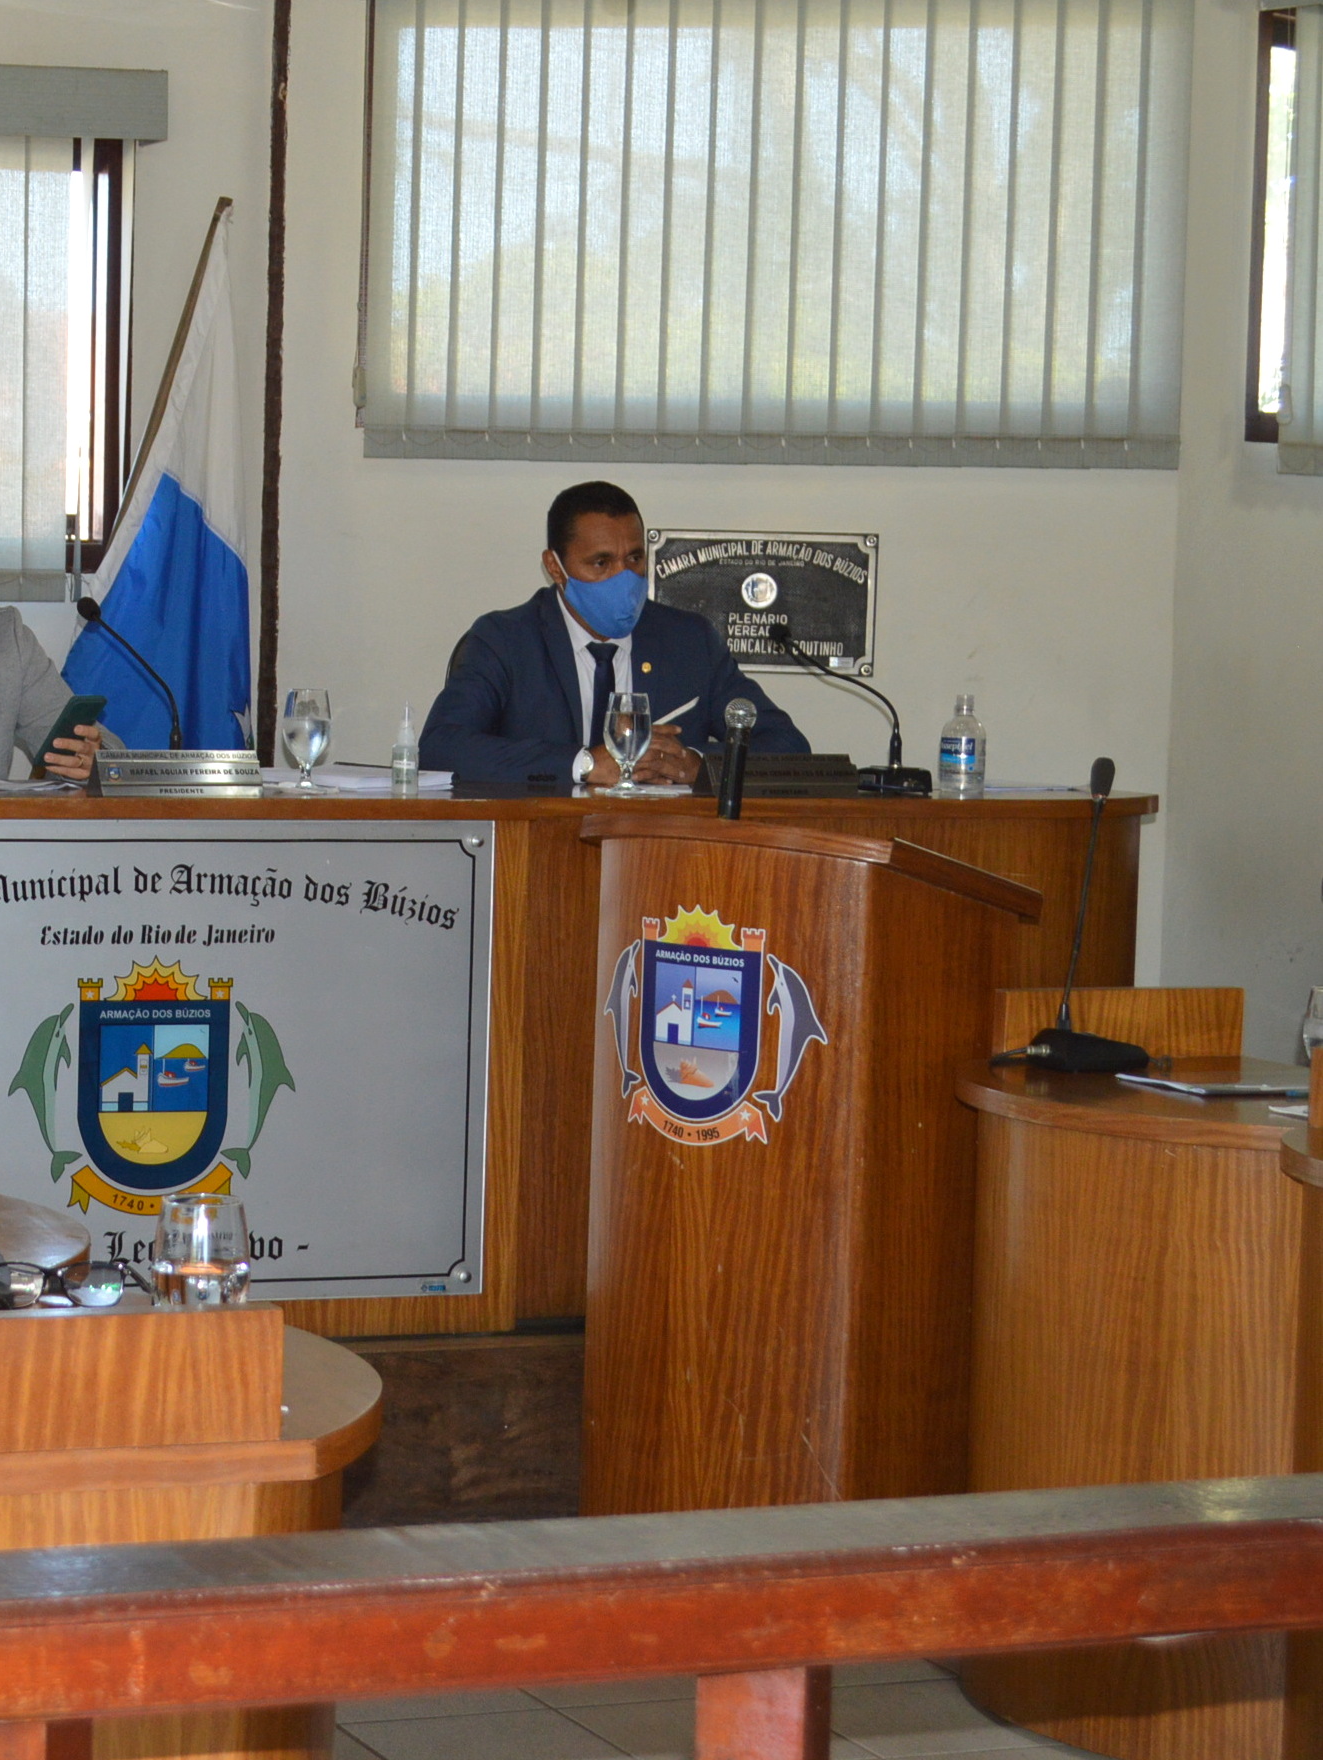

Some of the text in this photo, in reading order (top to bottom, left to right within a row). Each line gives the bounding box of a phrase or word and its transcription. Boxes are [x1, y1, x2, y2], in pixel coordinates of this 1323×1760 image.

[656, 541, 868, 584] CÂMARA MUNICIPAL DE ARMAÇÃO DOS BÚZIOS
[728, 611, 788, 626] PLENÁRIO
[792, 640, 844, 657] COUTINHO
[130, 768, 260, 776] RAFAEL AGUIAR PEREIRA DE SOUZA
[132, 866, 163, 895] de
[169, 863, 293, 907] Armação
[303, 874, 353, 907] dos
[360, 879, 460, 931] Búzios
[40, 923, 276, 947] Estado do Rio de Janeiro
[655, 949, 745, 968] ARMAÇÃO DOS BÚZIOS
[99, 1007, 211, 1020] ARMAÇÃO DOS BÚZIOS
[662, 1119, 721, 1141] 1740 1995
[112, 1193, 145, 1212] 1740
